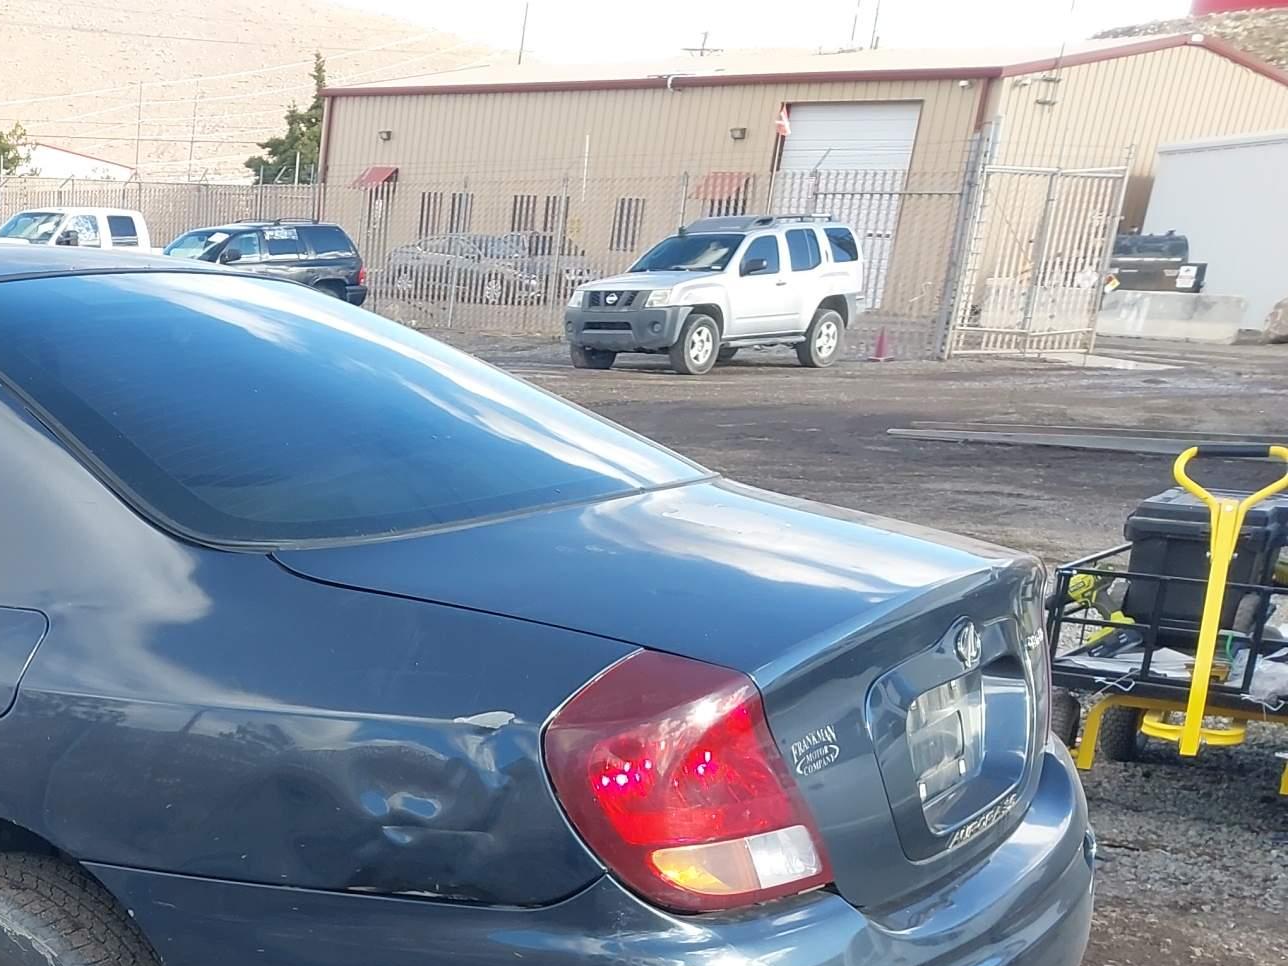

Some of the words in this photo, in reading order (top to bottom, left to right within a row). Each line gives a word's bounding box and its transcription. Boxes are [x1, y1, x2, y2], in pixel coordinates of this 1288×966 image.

[791, 725, 837, 765] FRANKMAN
[805, 745, 829, 763] MOTOR
[803, 751, 834, 776] COMPANY
